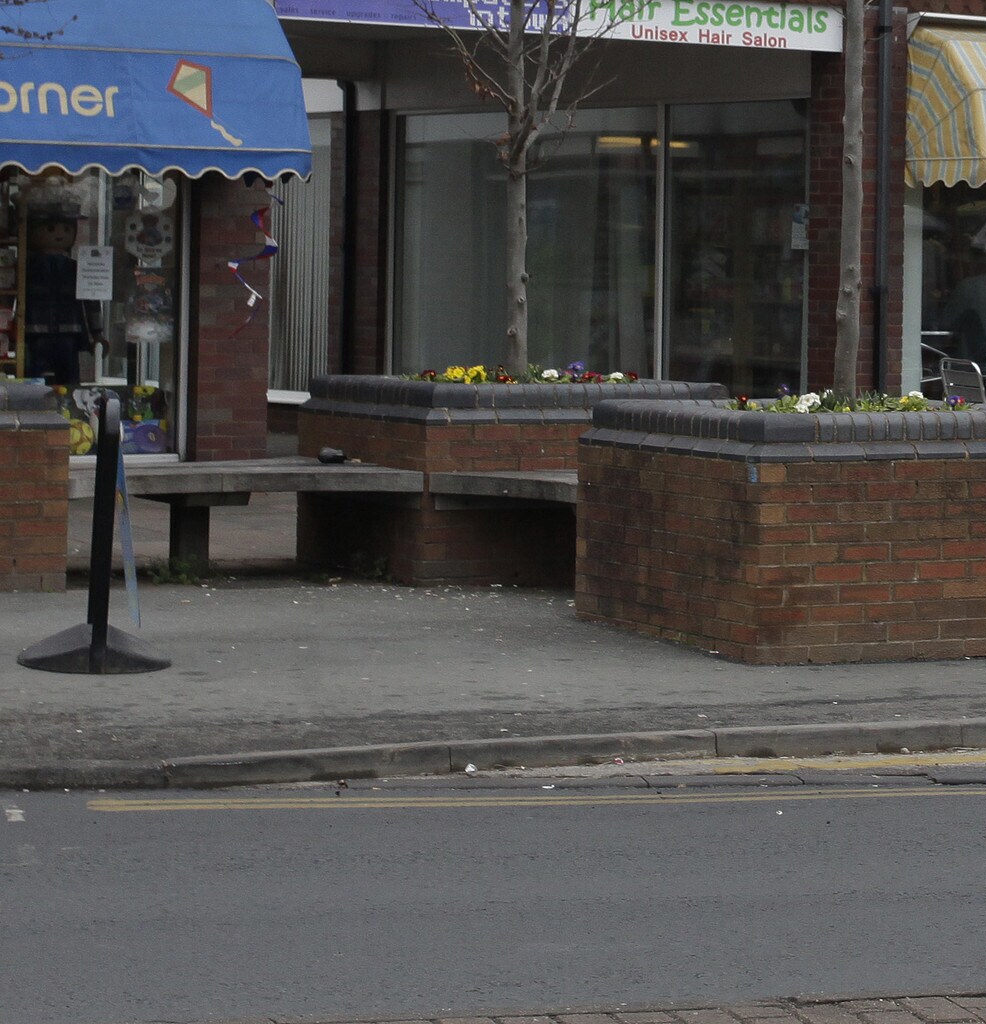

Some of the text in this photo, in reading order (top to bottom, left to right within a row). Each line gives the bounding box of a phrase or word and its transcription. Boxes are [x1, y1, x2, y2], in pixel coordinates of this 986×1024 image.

[631, 24, 787, 49] Unisex Hair Salon
